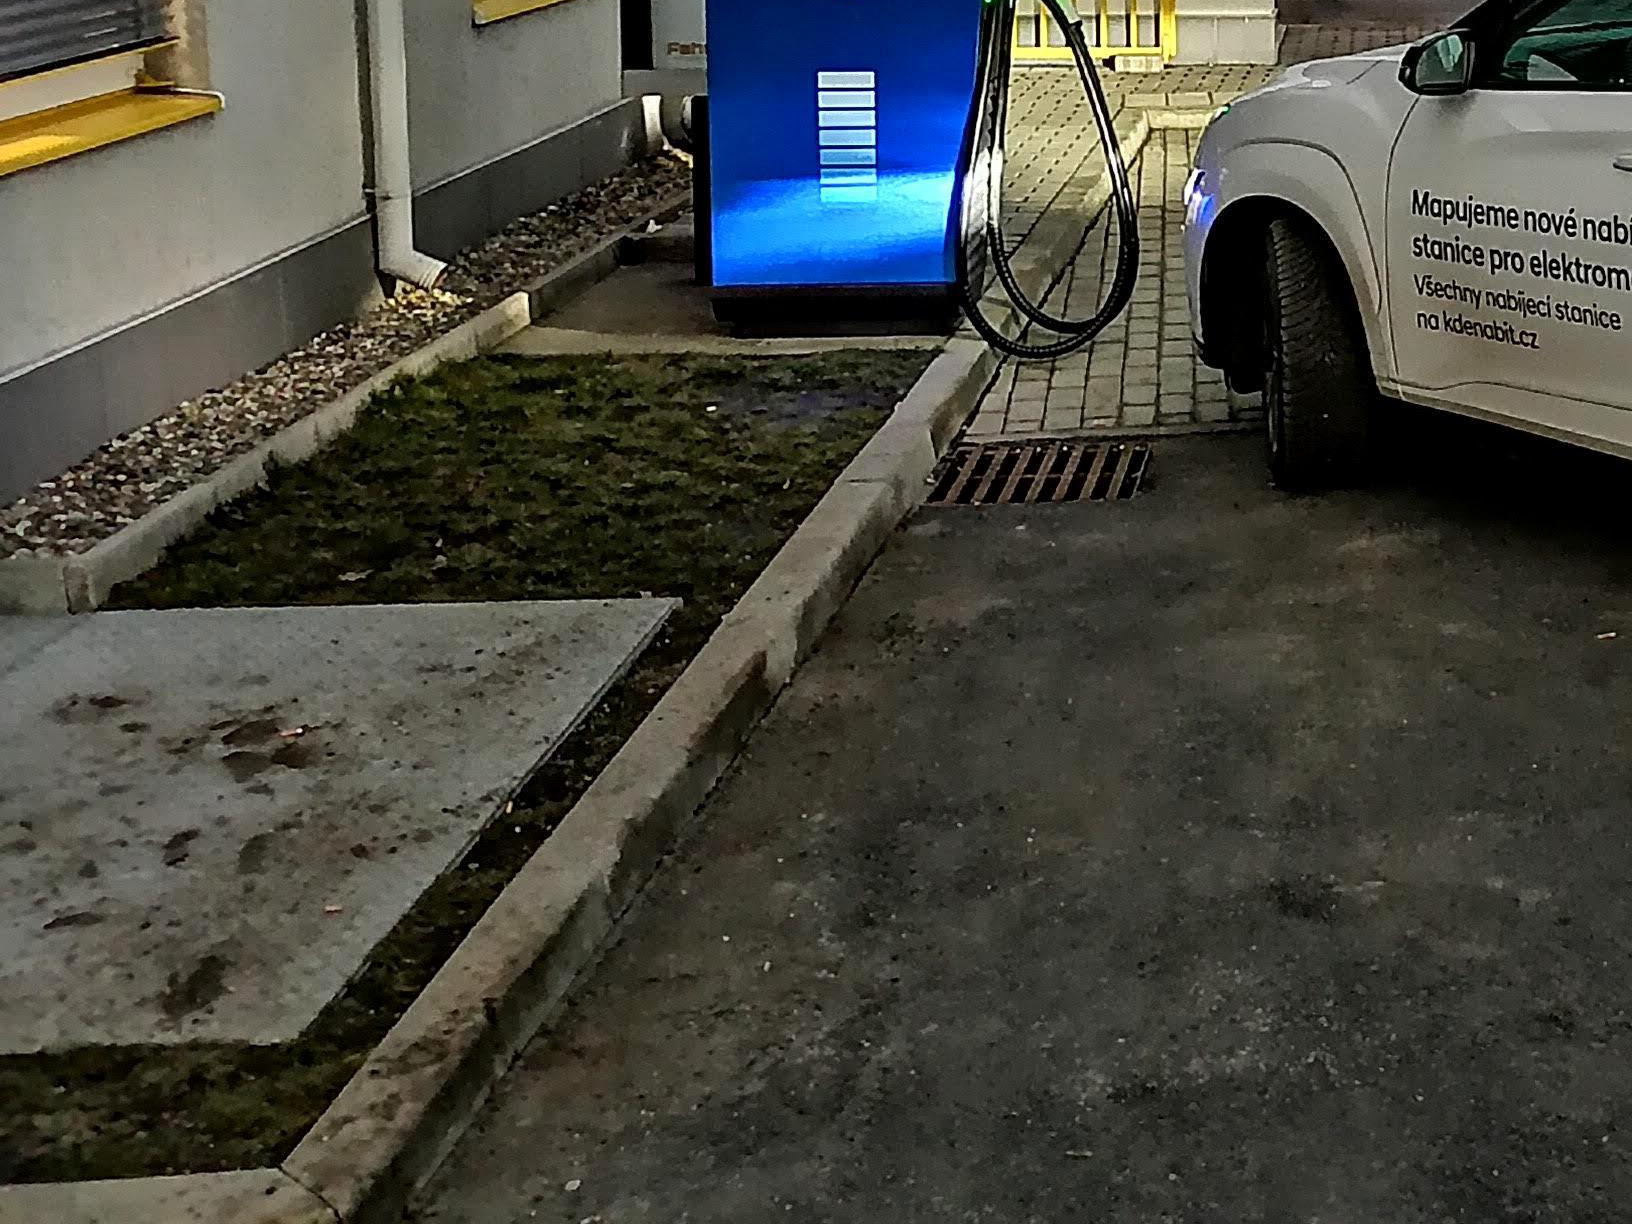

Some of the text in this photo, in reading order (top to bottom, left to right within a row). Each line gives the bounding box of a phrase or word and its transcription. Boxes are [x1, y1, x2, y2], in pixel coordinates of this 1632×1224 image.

[1411, 188, 1519, 229] Mapujeme
[1523, 207, 1578, 238] nové
[1412, 233, 1485, 267] stanice
[1489, 248, 1525, 276] pro
[1414, 274, 1482, 310] Všechny
[1554, 300, 1622, 331] stanice
[1416, 312, 1440, 331] na
